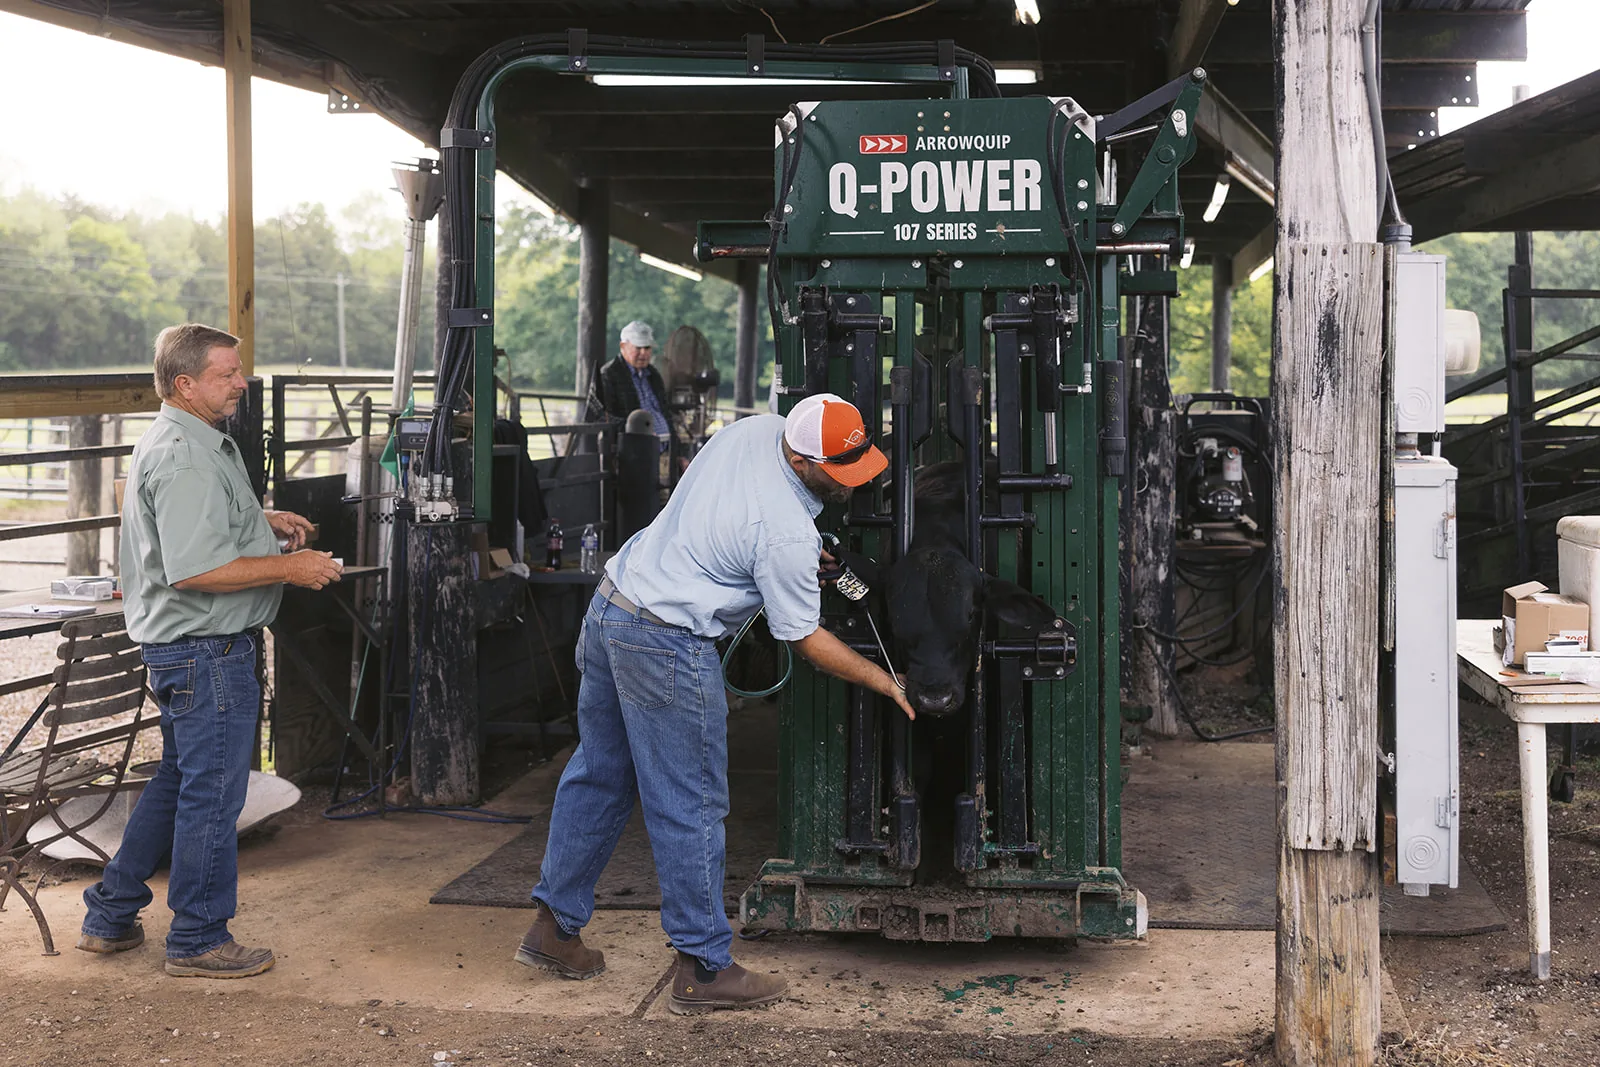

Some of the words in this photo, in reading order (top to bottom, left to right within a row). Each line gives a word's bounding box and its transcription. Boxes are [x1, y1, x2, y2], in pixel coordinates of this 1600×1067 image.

[915, 135, 1011, 151] ARROWQUIP
[829, 159, 1042, 219] Q-POWER
[893, 223, 920, 241] 107
[926, 223, 977, 240] SERIES
